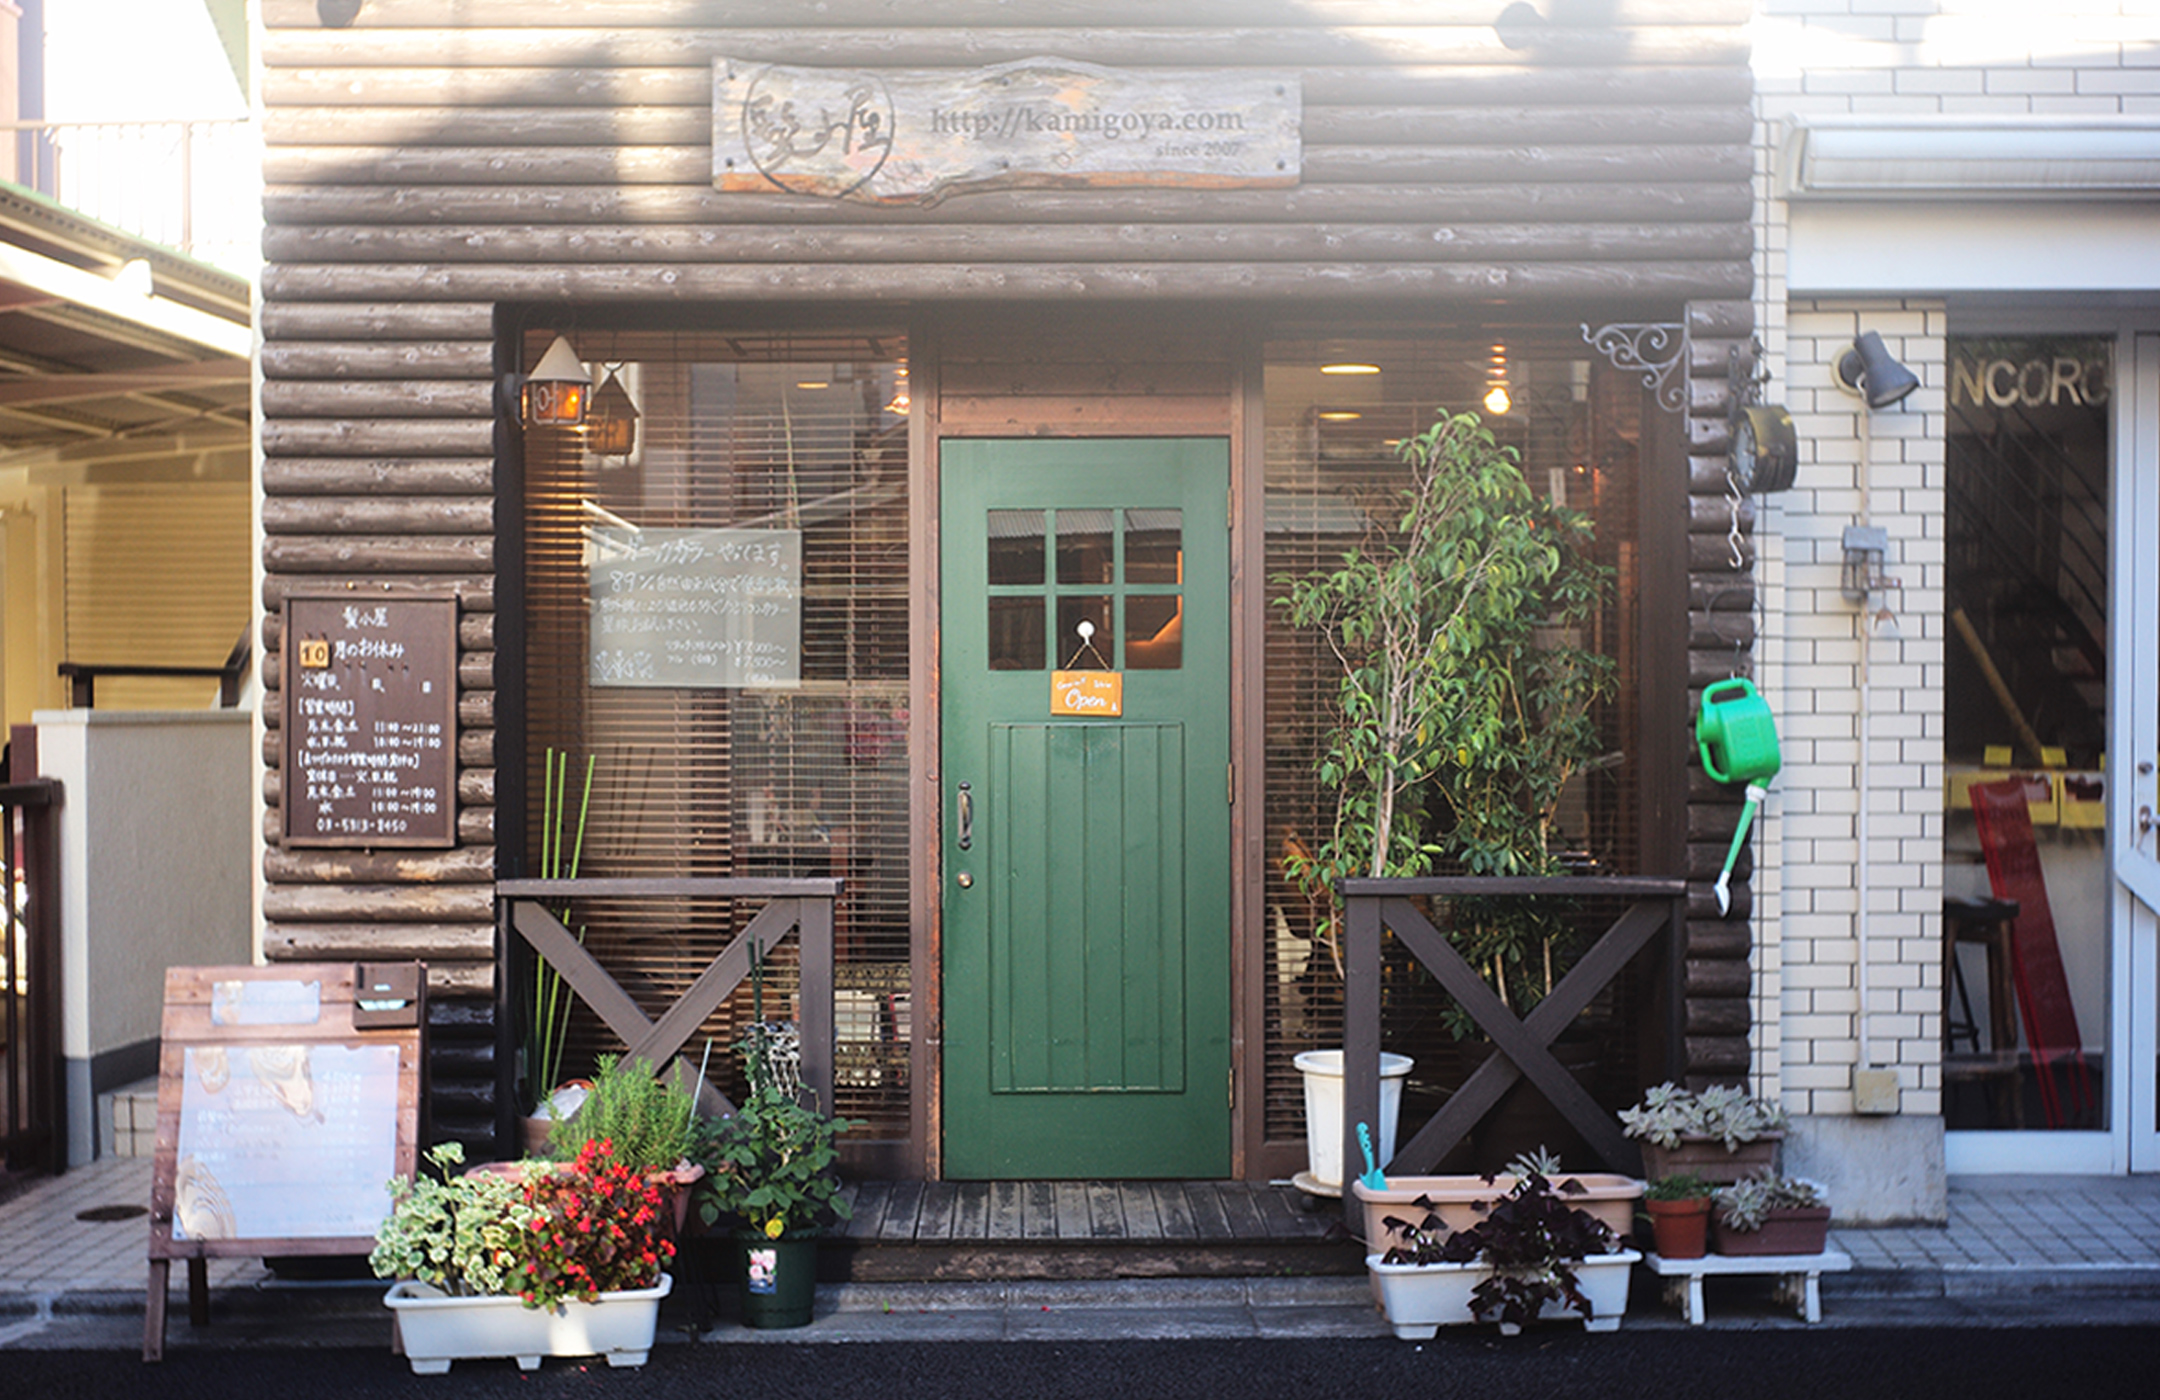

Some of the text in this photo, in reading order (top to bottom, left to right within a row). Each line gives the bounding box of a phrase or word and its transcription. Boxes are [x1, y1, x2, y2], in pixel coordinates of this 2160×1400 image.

[930, 108, 1245, 142] http://kamigoya.com
[1155, 142, 1199, 157] since
[301, 637, 405, 662] 10 月のお休み
[1065, 687, 1107, 711] Open
